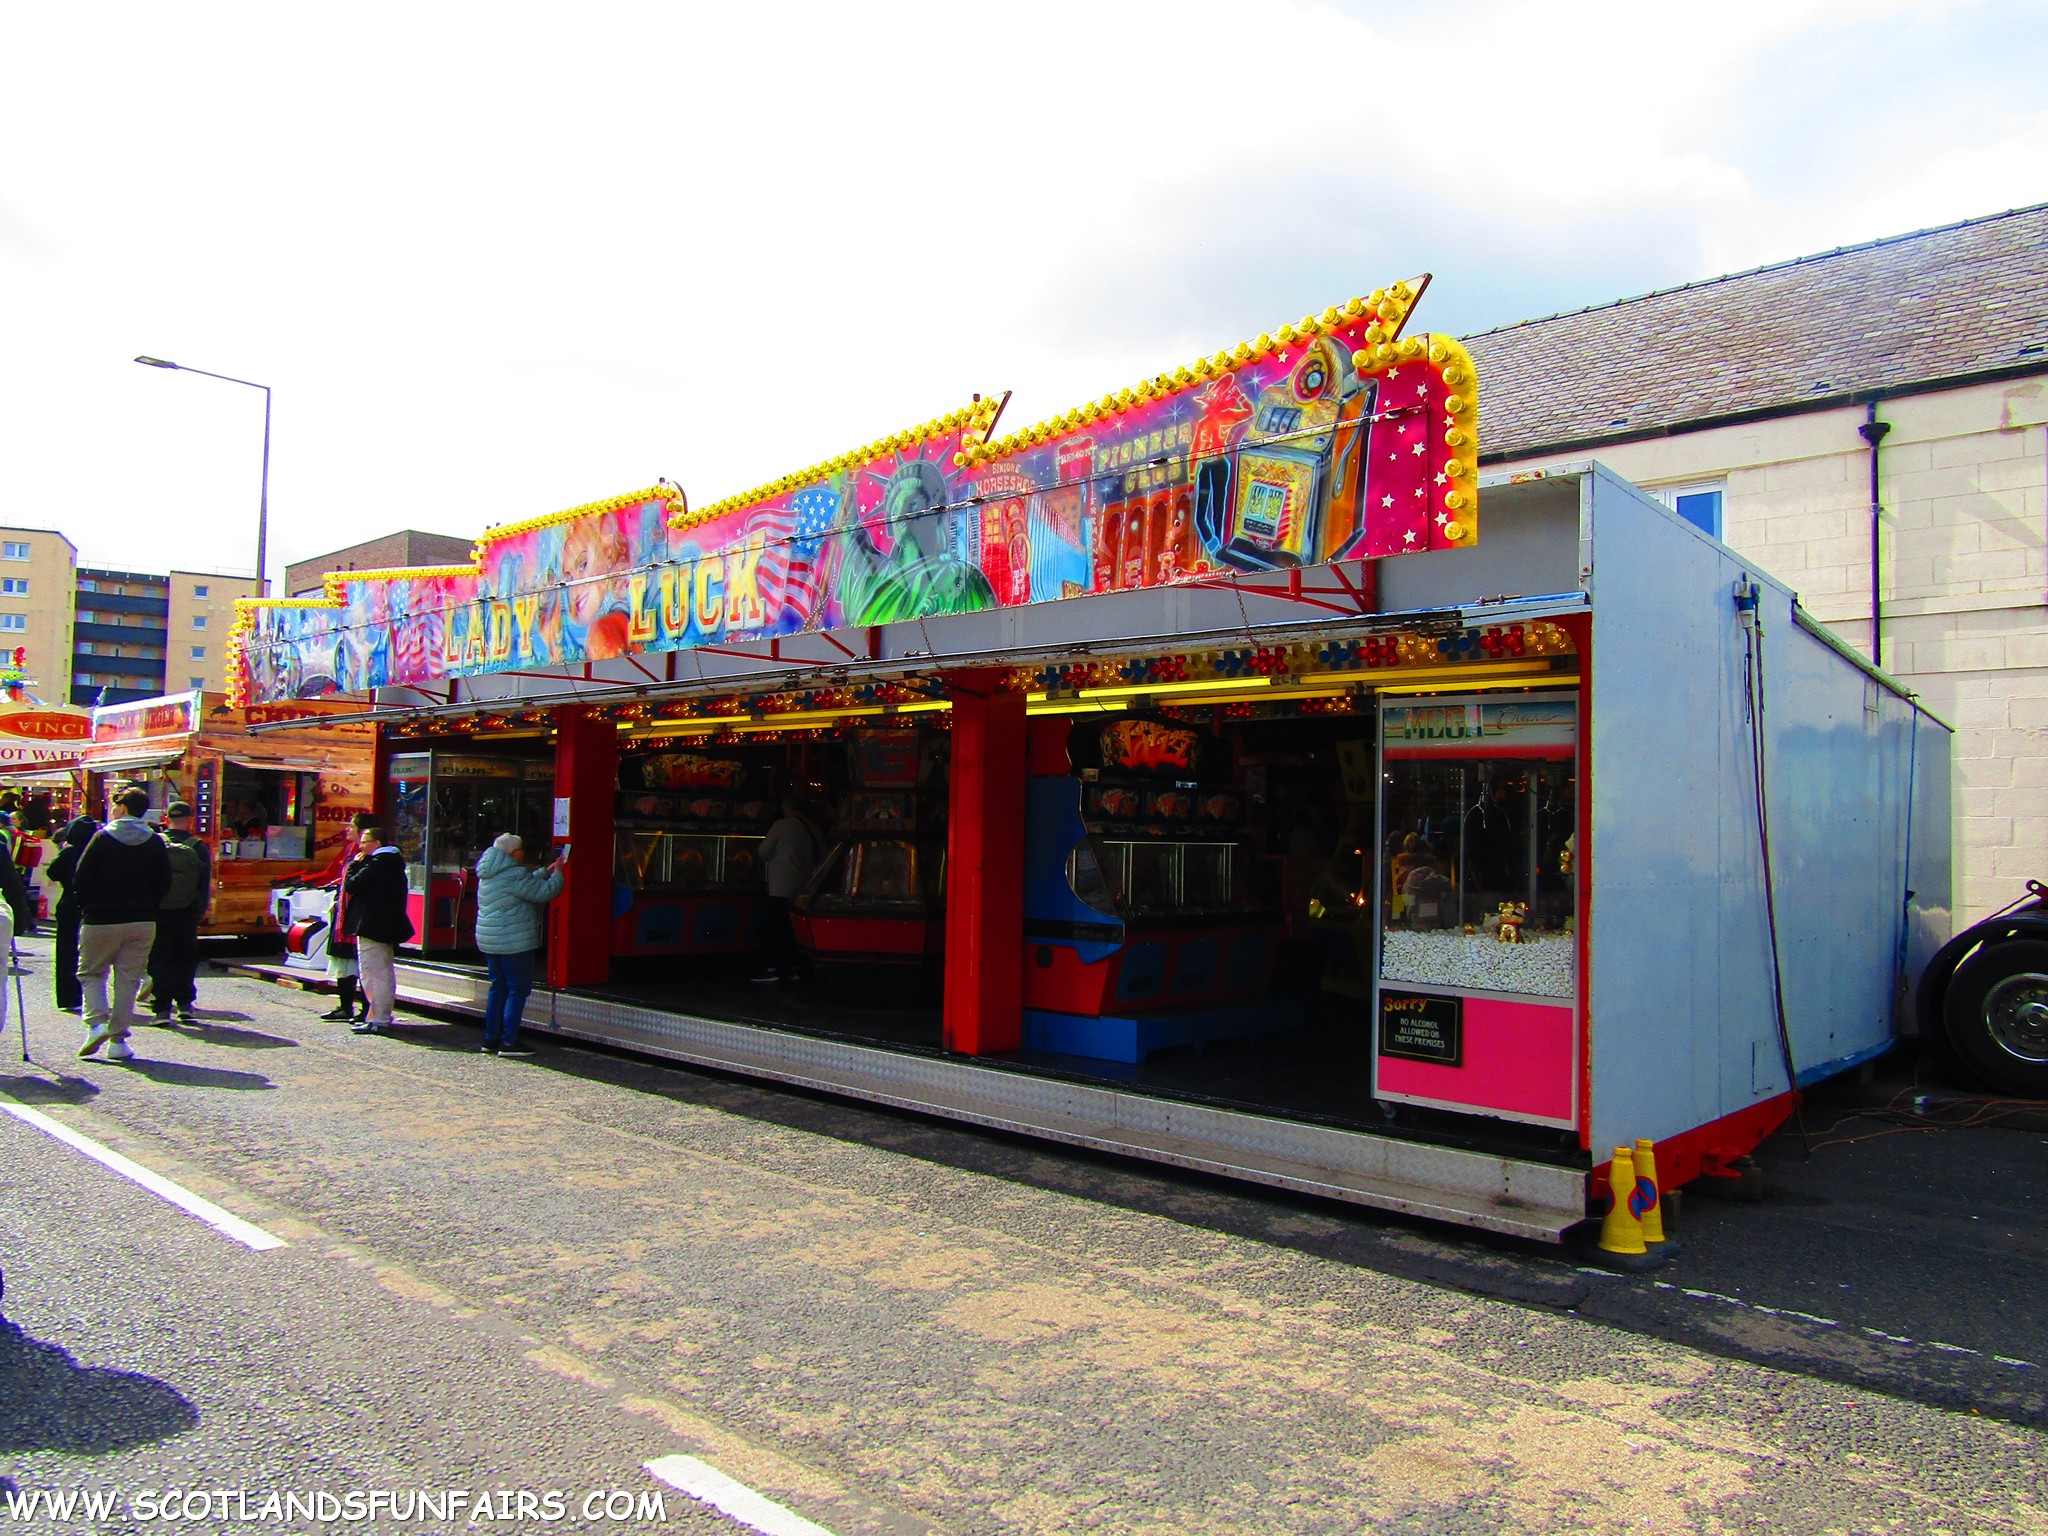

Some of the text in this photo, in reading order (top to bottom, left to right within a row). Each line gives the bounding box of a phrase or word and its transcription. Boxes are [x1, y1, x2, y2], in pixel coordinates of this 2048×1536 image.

[1097, 421, 1193, 473] PIONEER
[443, 528, 768, 670] LADY LUCK
[17, 720, 85, 735] VINCI
[0, 747, 26, 761] OT
[1383, 996, 1428, 1013] Sorry
[1400, 1017, 1440, 1030] NO ALCOHOL
[1400, 1026, 1440, 1038] ALLOWED ON
[1394, 1034, 1446, 1048] THESE PREMISES
